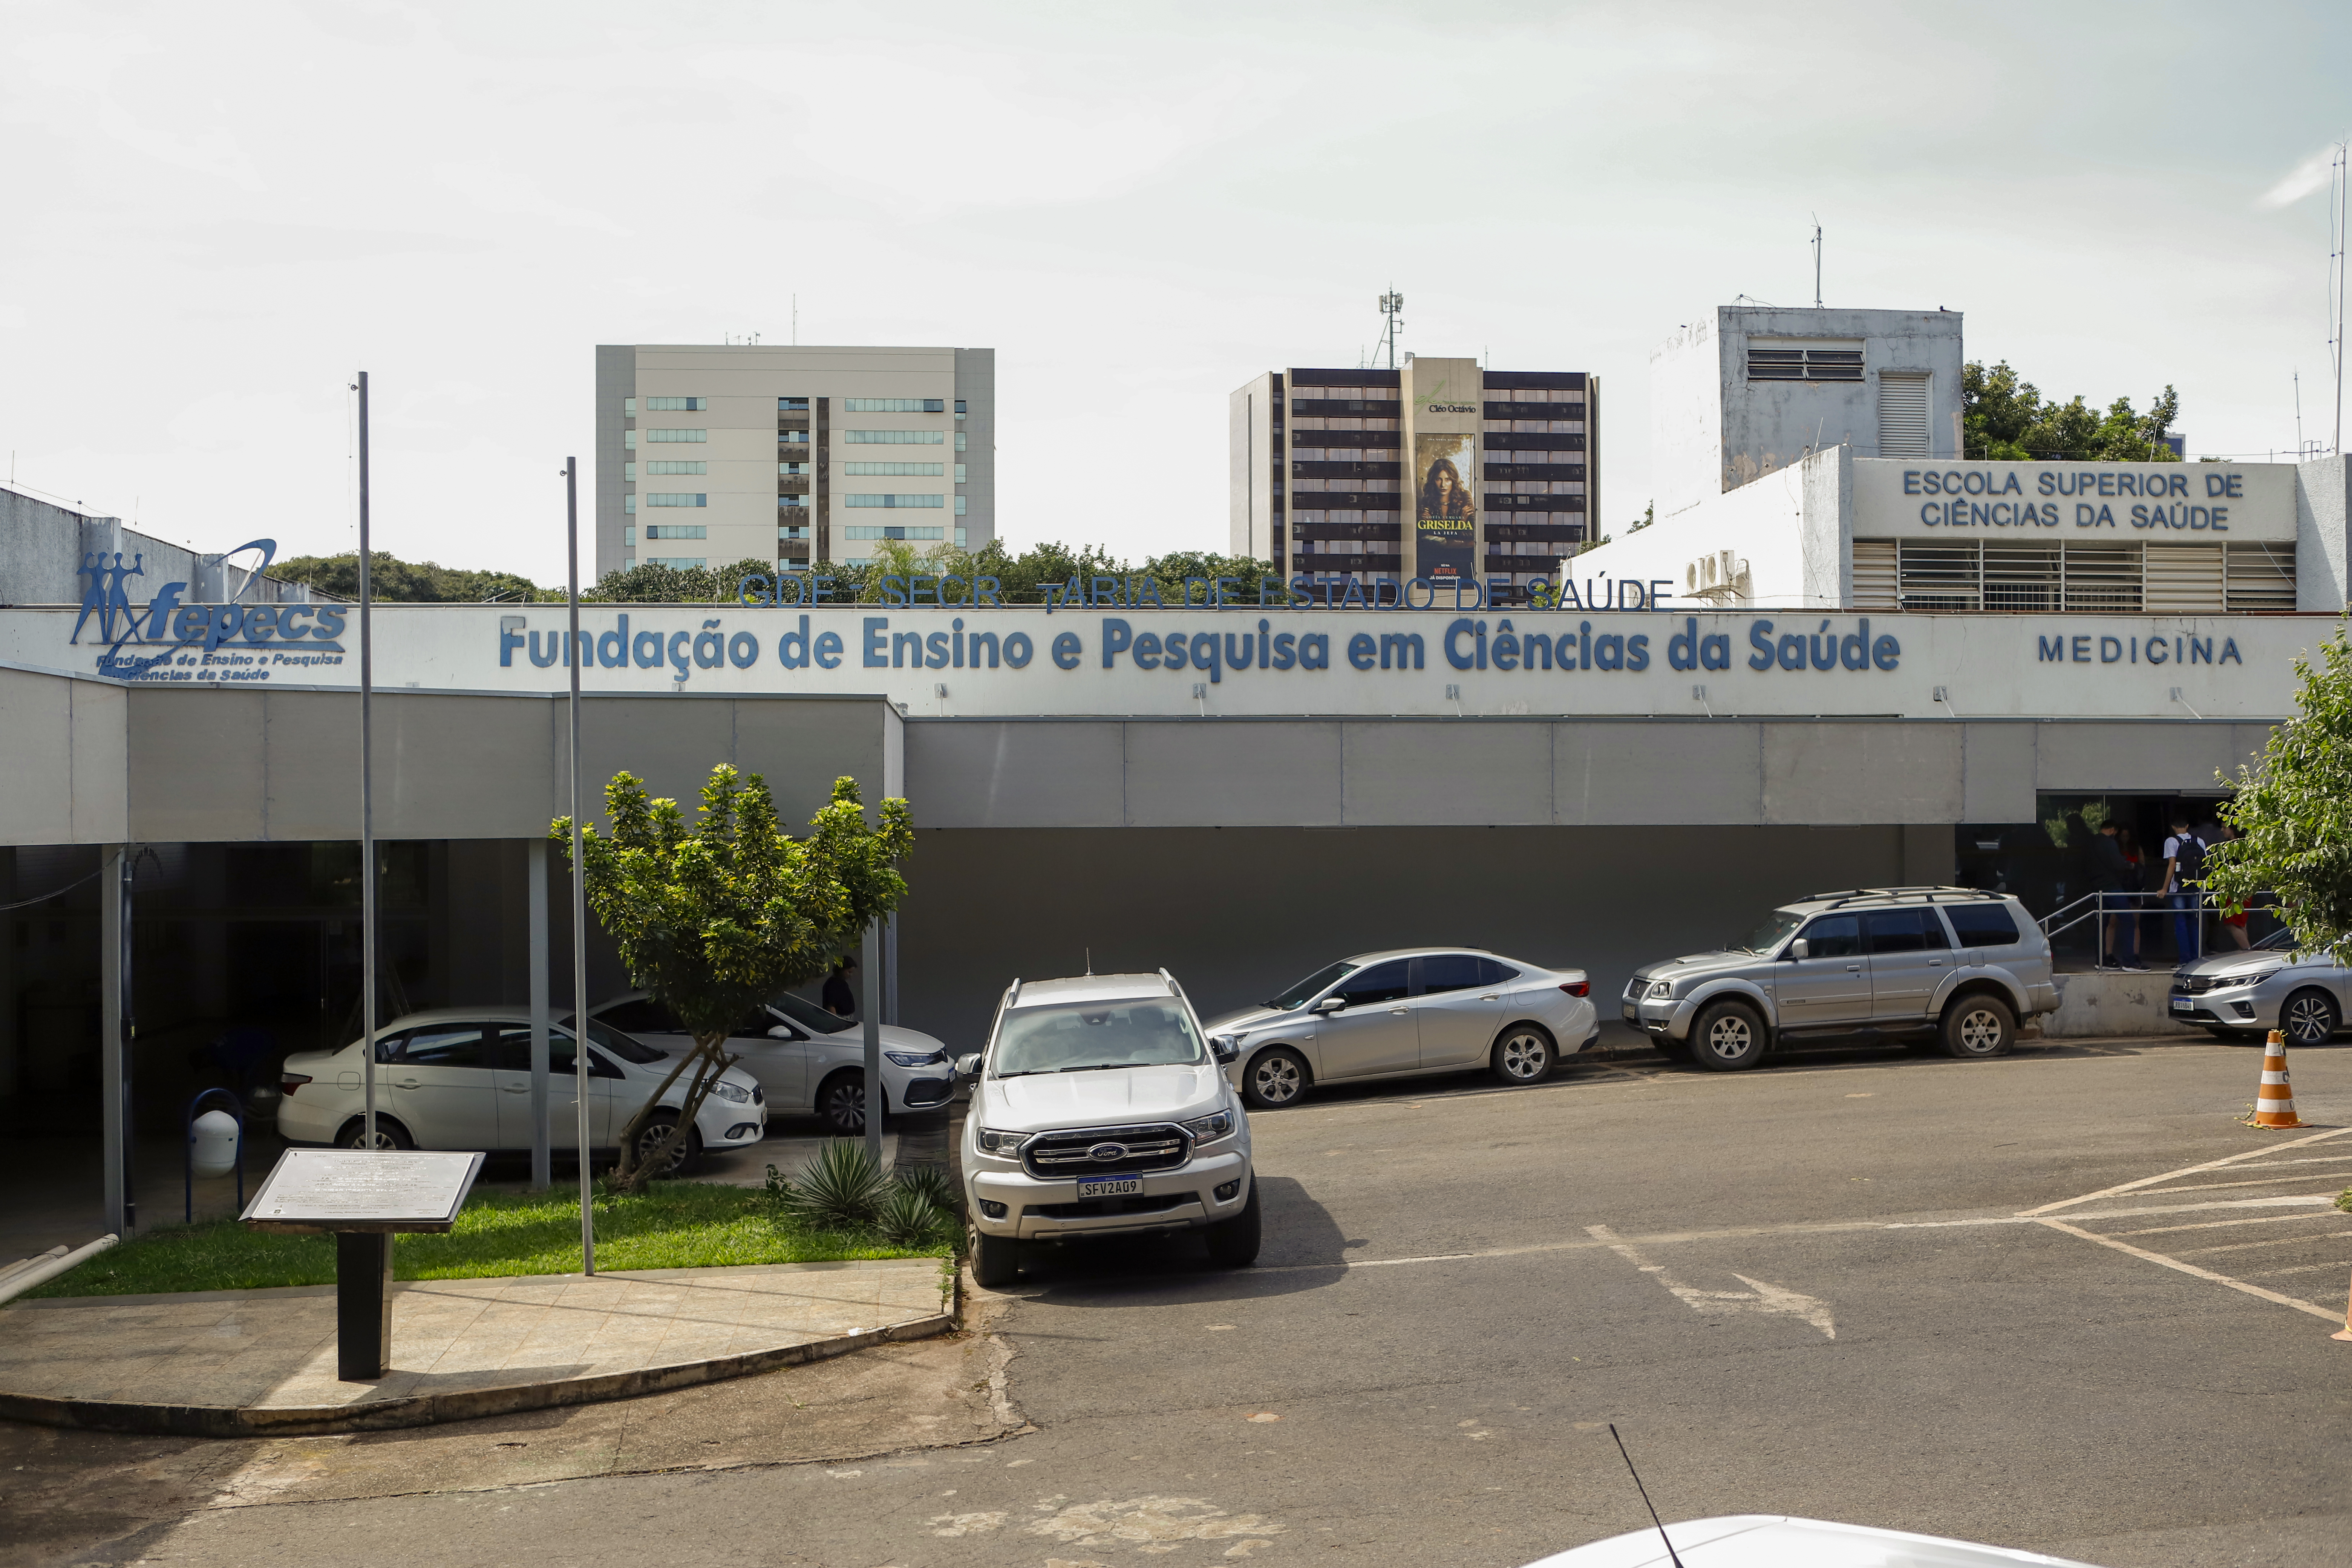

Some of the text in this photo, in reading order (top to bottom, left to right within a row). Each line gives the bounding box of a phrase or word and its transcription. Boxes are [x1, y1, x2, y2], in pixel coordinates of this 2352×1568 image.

[1429, 404, 1476, 413] Cléo Octávio
[1904, 471, 2243, 497] ESCOLA SUPERIOR DE
[1921, 497, 2228, 530] CIÊNCIAS DA SAÚDE
[1417, 520, 1473, 530] GRISELDA
[738, 574, 836, 609] GDF
[1185, 577, 1242, 610] DE
[1260, 575, 1435, 611] ESTADO
[1455, 577, 1512, 611] DE
[1527, 571, 1675, 612] SAÚDE
[146, 582, 348, 652] fepecs
[500, 614, 1901, 683] Fundação de Ensino e Pesquisa em Ciências da Saúde
[2038, 635, 2242, 664] MEDICINA
[177, 654, 196, 666] de
[201, 653, 253, 666] Ensino
[258, 656, 268, 665] e
[272, 653, 343, 667] Pesquisa
[197, 669, 216, 680] da
[220, 669, 270, 681] Saúde
[1097, 1147, 1118, 1157] Ford
[1085, 1181, 1136, 1195] SFV2A09
